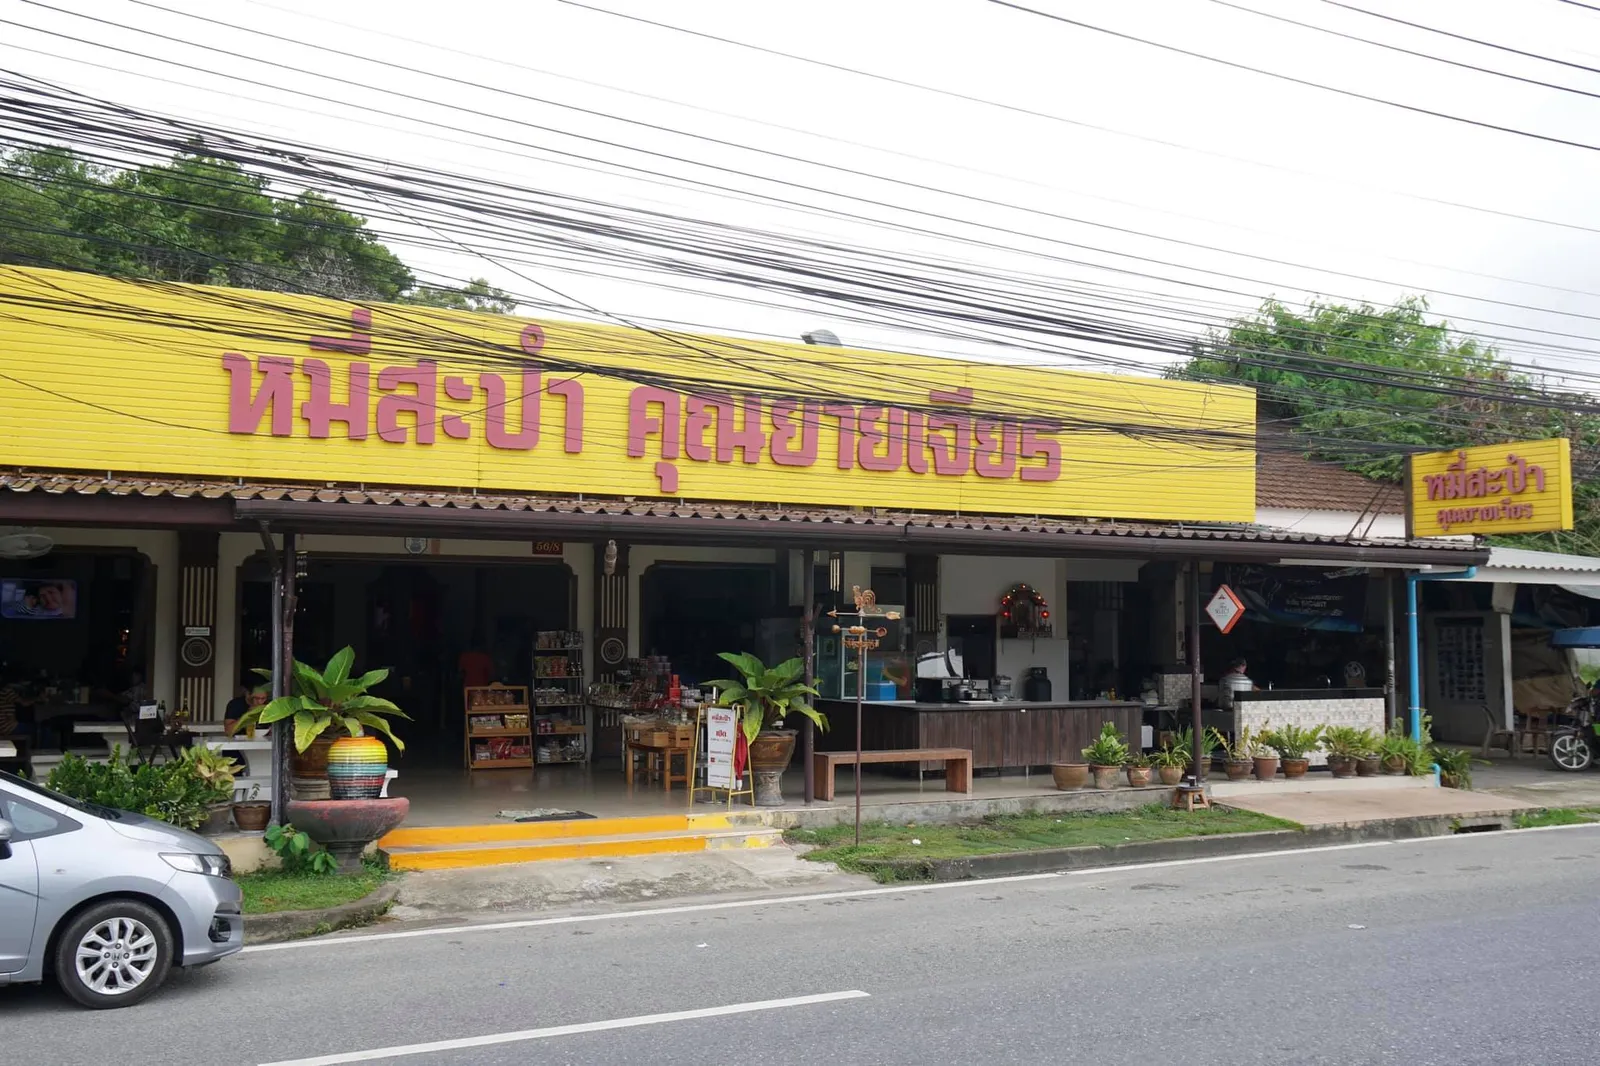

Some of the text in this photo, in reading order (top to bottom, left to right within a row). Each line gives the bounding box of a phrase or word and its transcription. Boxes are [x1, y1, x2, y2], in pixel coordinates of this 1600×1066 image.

[222, 308, 1062, 494] หมี่สะปำ คุณยายเจียร
[1422, 451, 1546, 501] หมี่สะปำ
